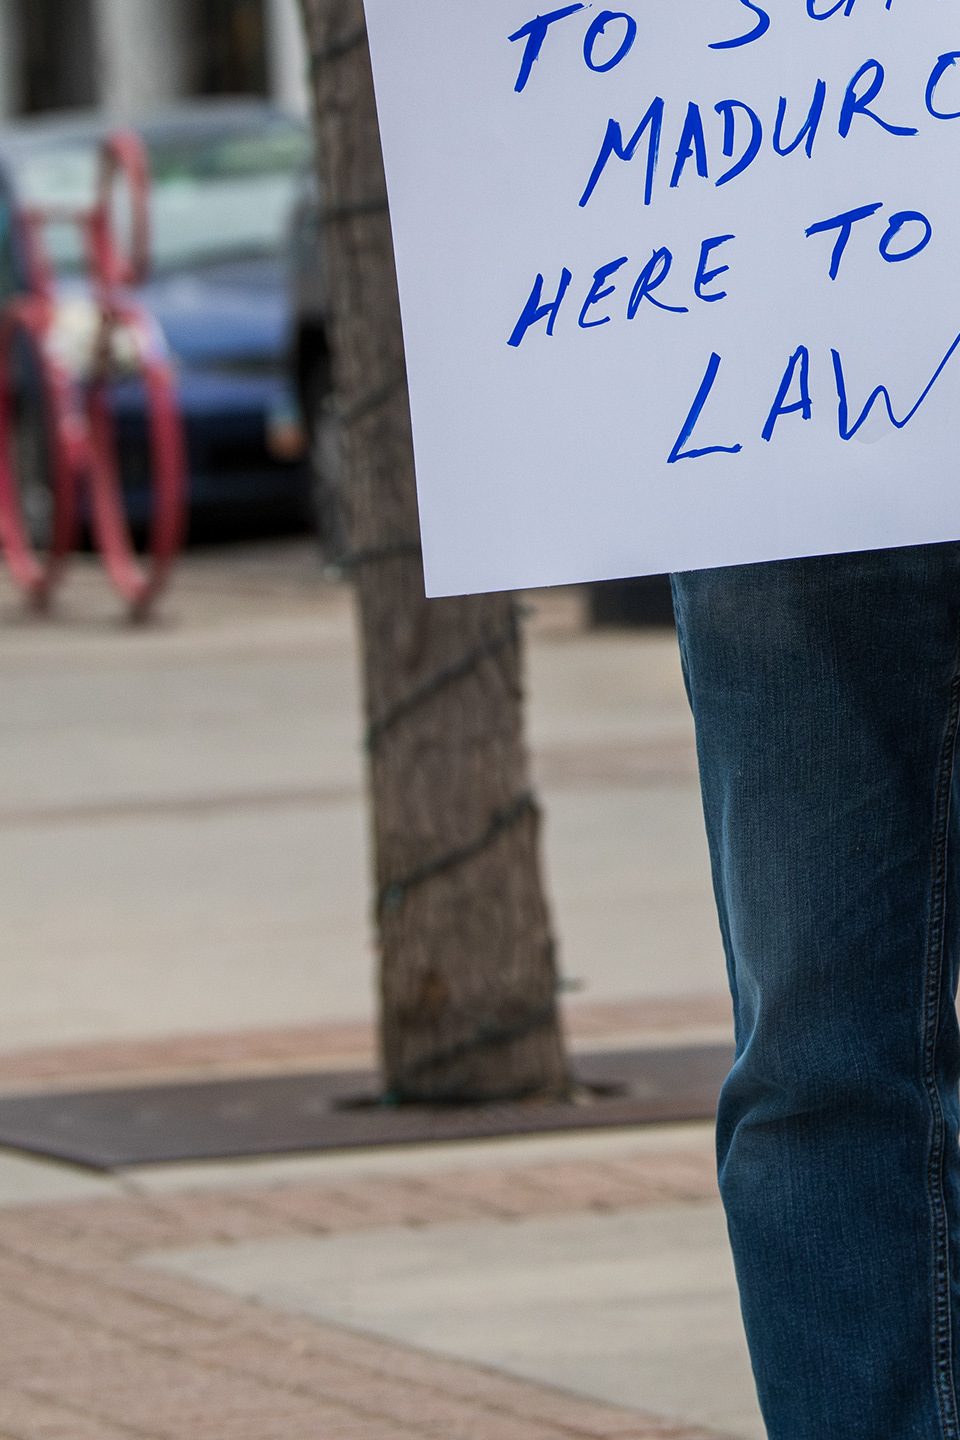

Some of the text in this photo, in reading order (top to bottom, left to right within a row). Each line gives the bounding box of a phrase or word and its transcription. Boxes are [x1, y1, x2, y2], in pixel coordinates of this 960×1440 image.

[507, 1, 638, 94] TO
[506, 233, 736, 348] HERE
[803, 201, 933, 281] TO
